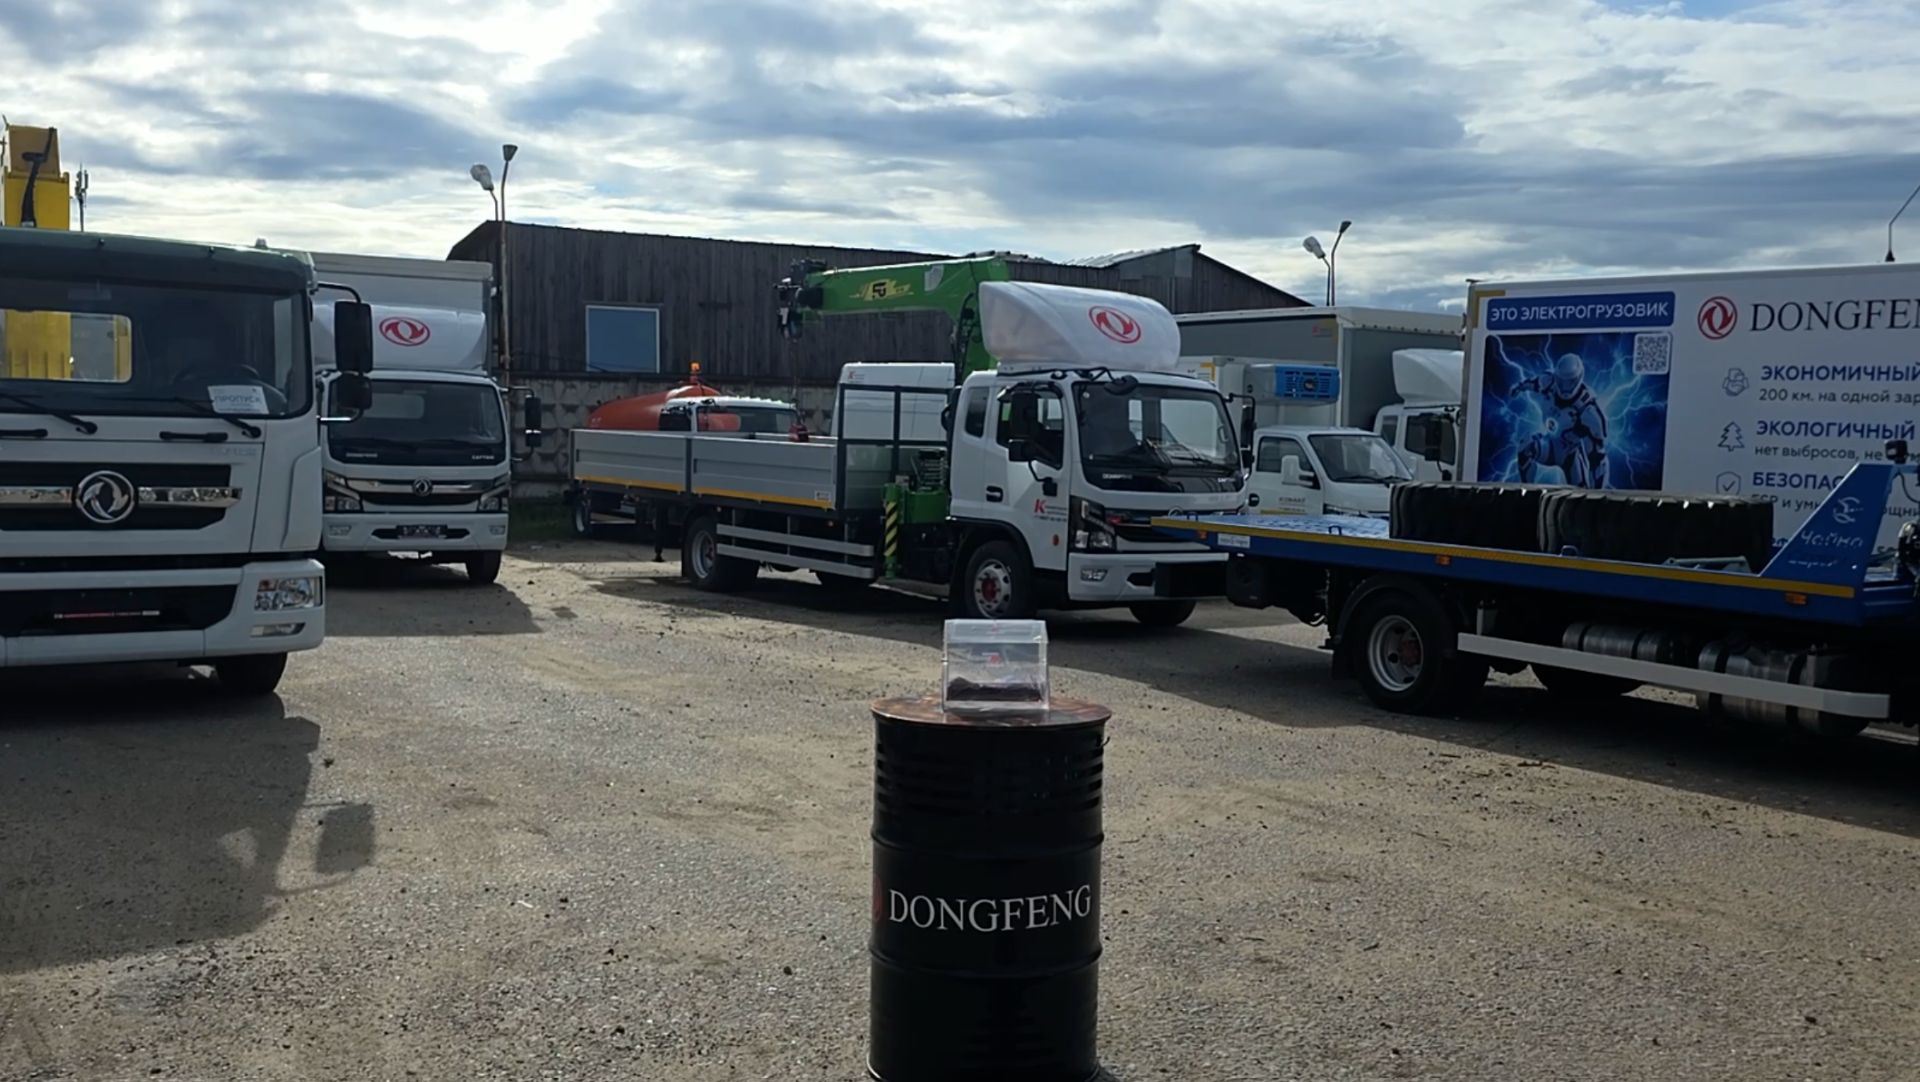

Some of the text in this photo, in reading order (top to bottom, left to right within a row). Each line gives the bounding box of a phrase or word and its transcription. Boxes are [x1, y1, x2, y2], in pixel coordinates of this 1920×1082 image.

[1491, 302, 1669, 321] ЭТО ЭЛЕКТРОГРУЗОВИК
[1760, 361, 1920, 381] ЭКОНОМИЧНЫЙ
[1759, 388, 1788, 401] 200
[1792, 392, 1814, 401] км.
[1818, 392, 1837, 402] на
[1840, 391, 1890, 404] одной
[1756, 420, 1915, 440] ЭКОЛОГИЧНЫЙ
[1755, 444, 1883, 462] нет выбросов, не
[889, 884, 1092, 932] DONGFENG
